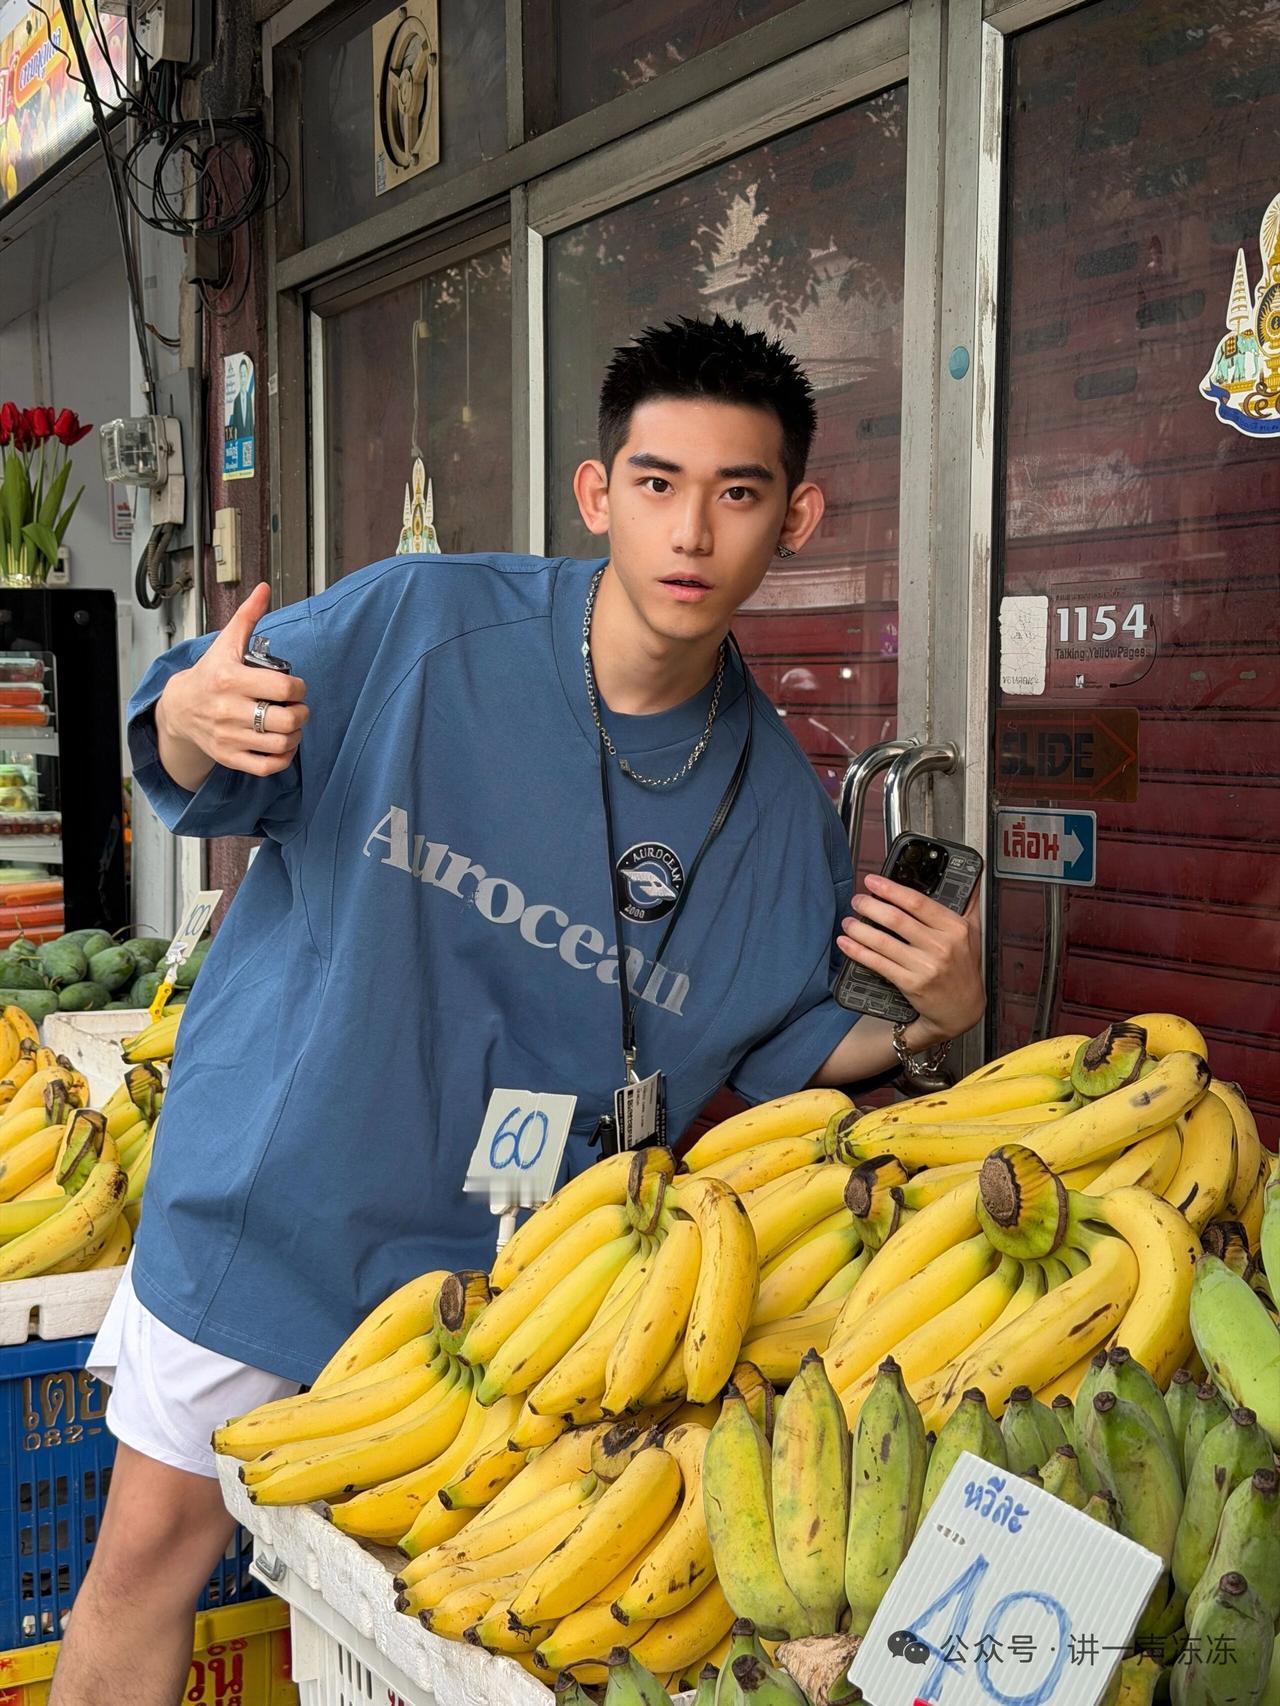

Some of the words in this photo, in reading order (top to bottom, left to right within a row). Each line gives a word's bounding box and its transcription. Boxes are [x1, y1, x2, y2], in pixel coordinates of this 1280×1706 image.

[1056, 603, 1148, 642] 1154
[1055, 648, 1086, 661] Talking
[1001, 732, 1095, 778] SLIDE
[1003, 816, 1060, 861] เลื่อน
[633, 847, 682, 882] AUROCEAN
[362, 805, 690, 1017] Aurocean
[624, 904, 645, 919] 2000
[489, 1106, 549, 1170] 60
[902, 1552, 1073, 1706] 40
